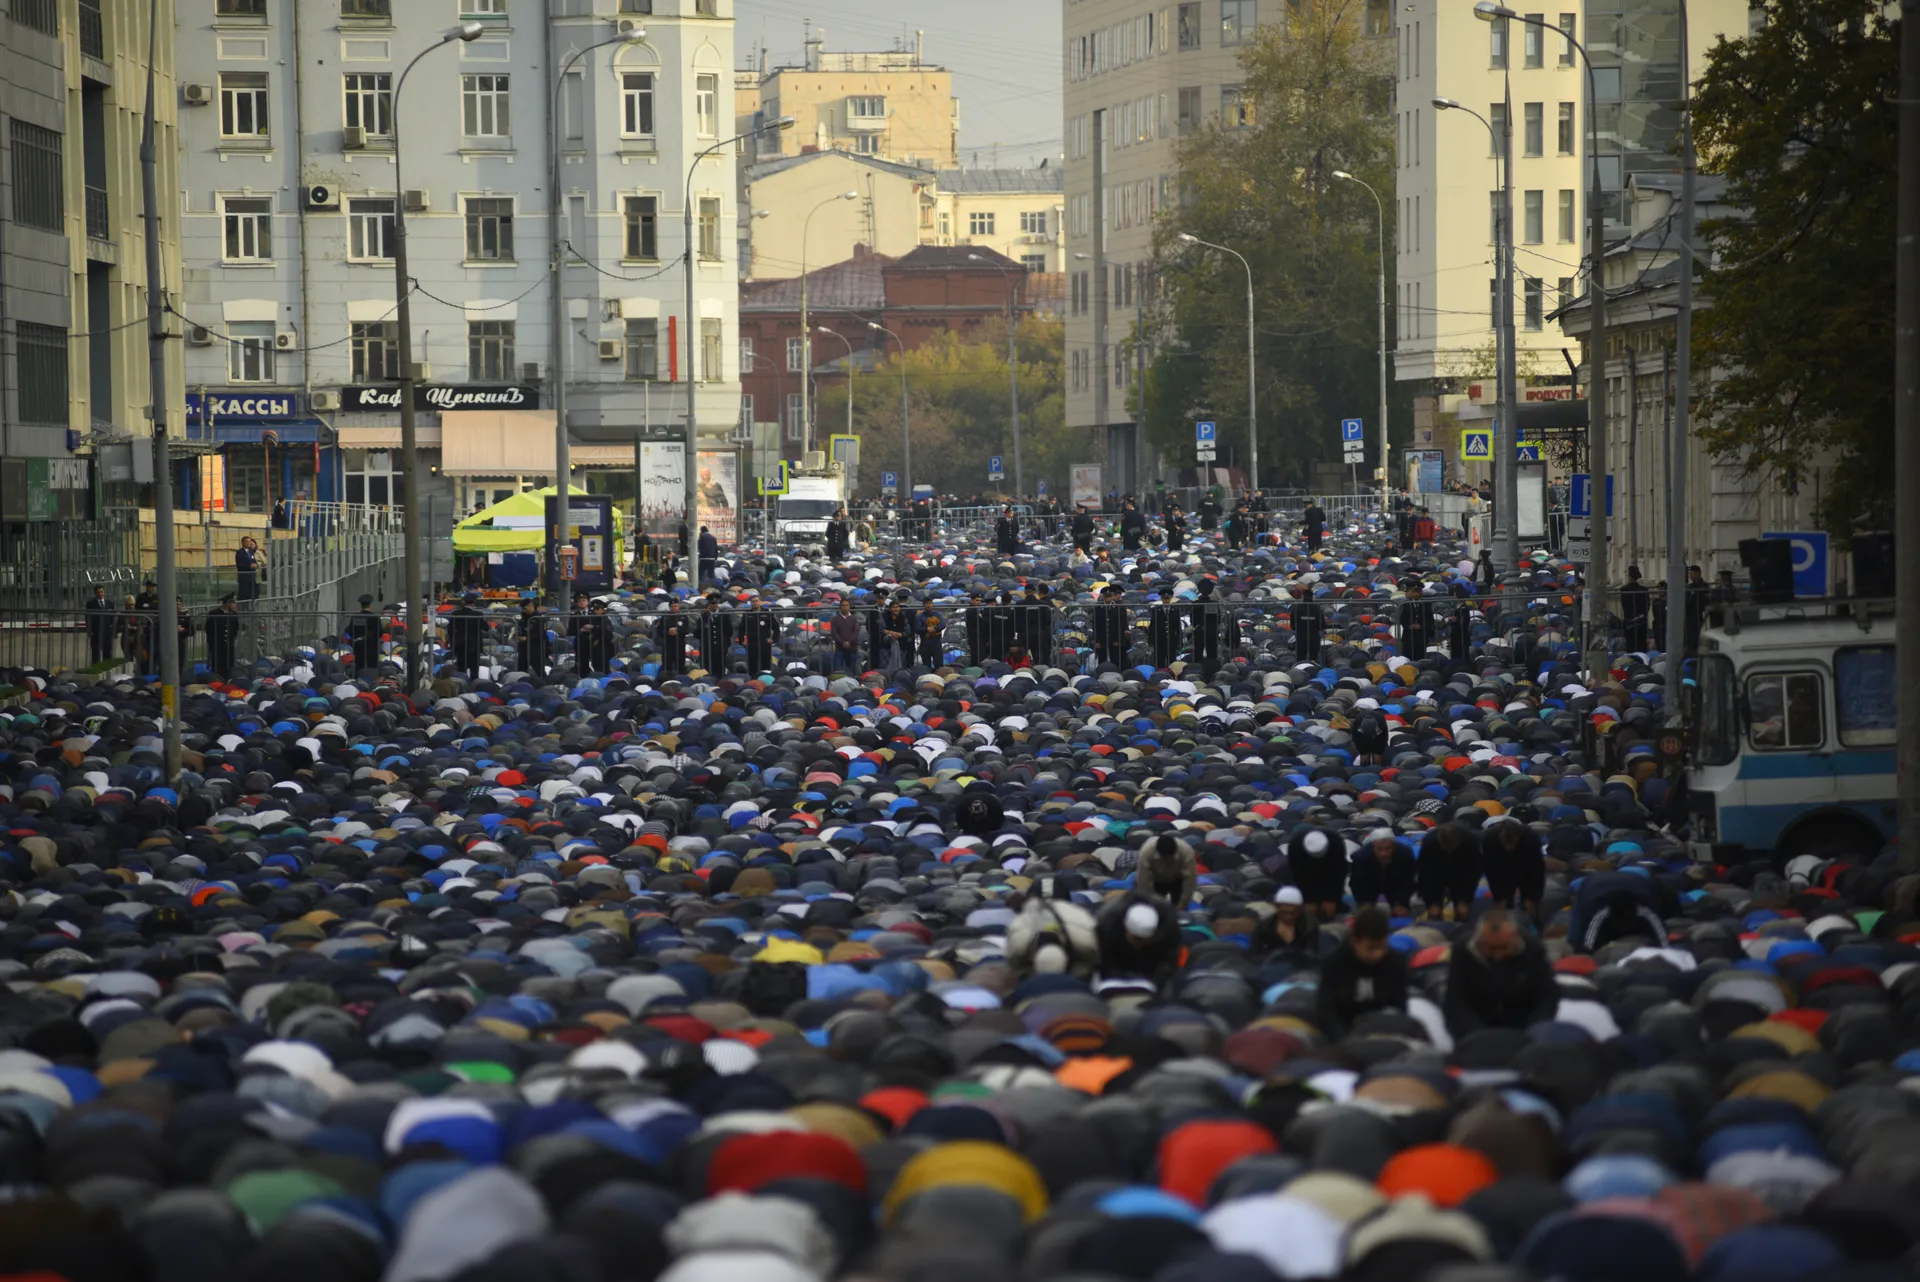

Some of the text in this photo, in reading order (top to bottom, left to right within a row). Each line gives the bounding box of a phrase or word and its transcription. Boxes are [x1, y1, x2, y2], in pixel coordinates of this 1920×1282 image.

[359, 389, 402, 407] Каф
[211, 400, 289, 415] КАССЫ
[1201, 425, 1211, 438] P
[1347, 422, 1358, 438] P
[991, 458, 1000, 471] P
[886, 473, 894, 485] P
